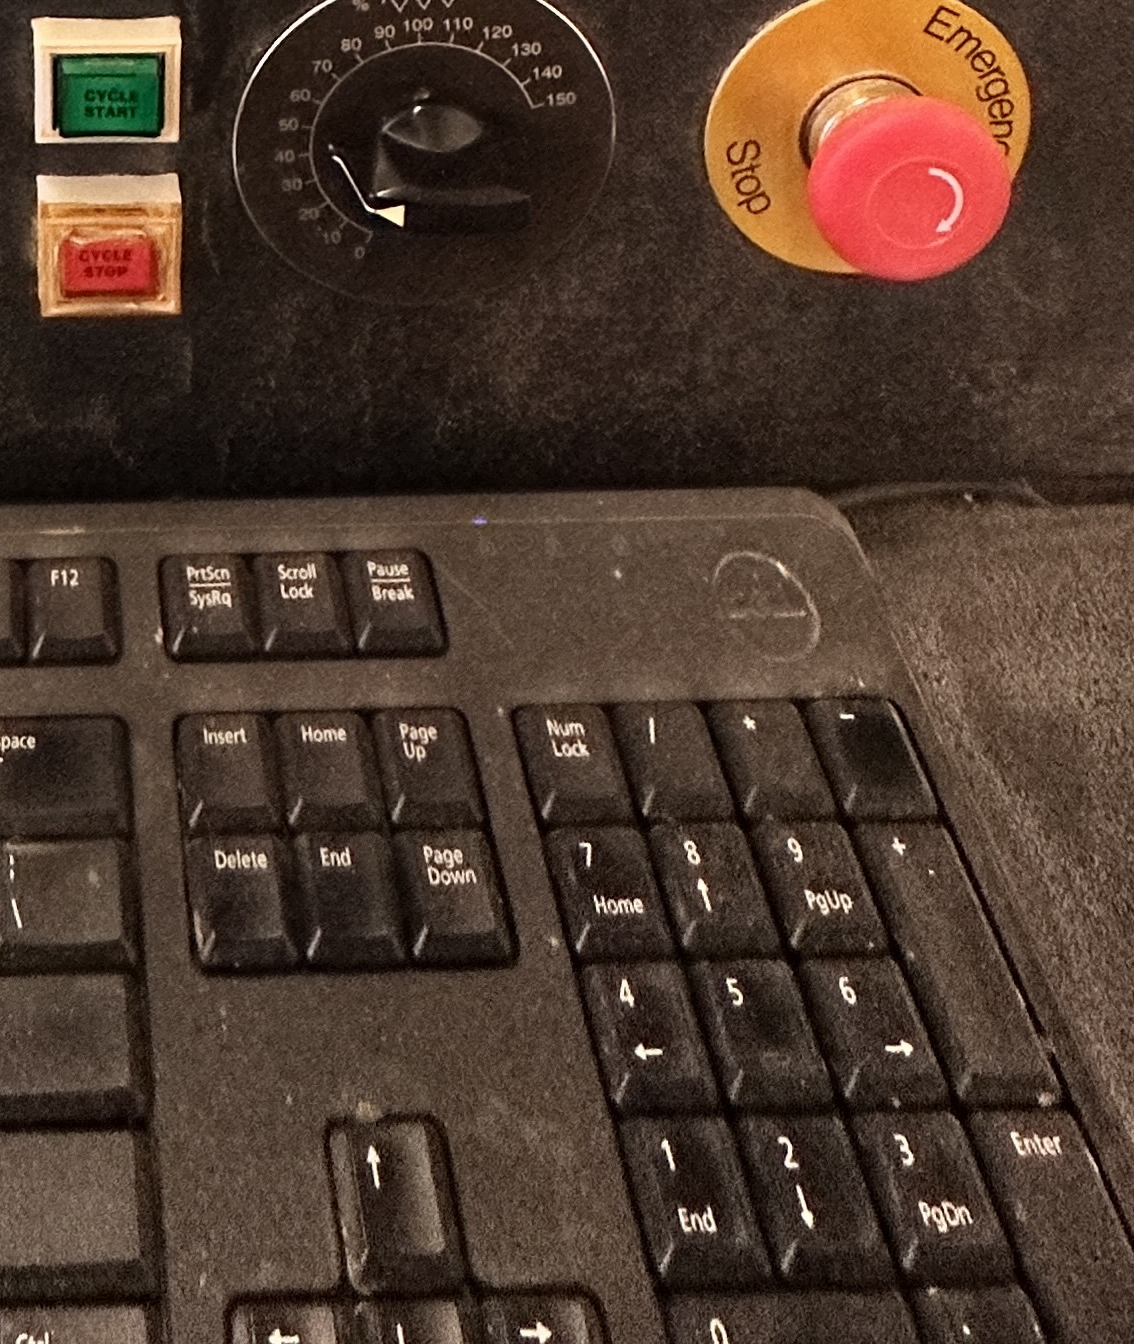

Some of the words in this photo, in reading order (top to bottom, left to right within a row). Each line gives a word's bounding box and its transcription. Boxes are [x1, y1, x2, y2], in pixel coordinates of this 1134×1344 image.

[403, 17, 434, 32] 100
[482, 24, 513, 40] 120
[312, 59, 333, 74] 70
[83, 88, 140, 103] CYCLE
[546, 91, 577, 106] 150
[83, 105, 139, 119] START
[725, 138, 772, 216] Stop
[78, 248, 133, 263] CYCLE
[82, 265, 128, 279] STOP
[50, 569, 80, 587] F12
[186, 565, 231, 583] PrtScn
[277, 563, 317, 581] Scroll
[368, 561, 410, 579] Pause
[187, 587, 233, 610] SysRq
[280, 582, 314, 600] Lock
[371, 584, 415, 602] Break
[203, 726, 248, 745] Insert
[301, 725, 347, 743] Home
[399, 723, 438, 747] Page
[545, 718, 586, 737] Num
[403, 741, 427, 762] Up
[551, 739, 590, 758] Lock
[214, 849, 268, 870] Delete
[319, 847, 352, 867] End
[423, 845, 464, 868] Page
[684, 839, 701, 866] 8
[427, 865, 477, 887] Down
[592, 894, 645, 915] Home
[804, 890, 854, 914] PgUp
[1009, 1130, 1063, 1157] Enter
[678, 1207, 718, 1235] End
[918, 1200, 973, 1233] PgDn
